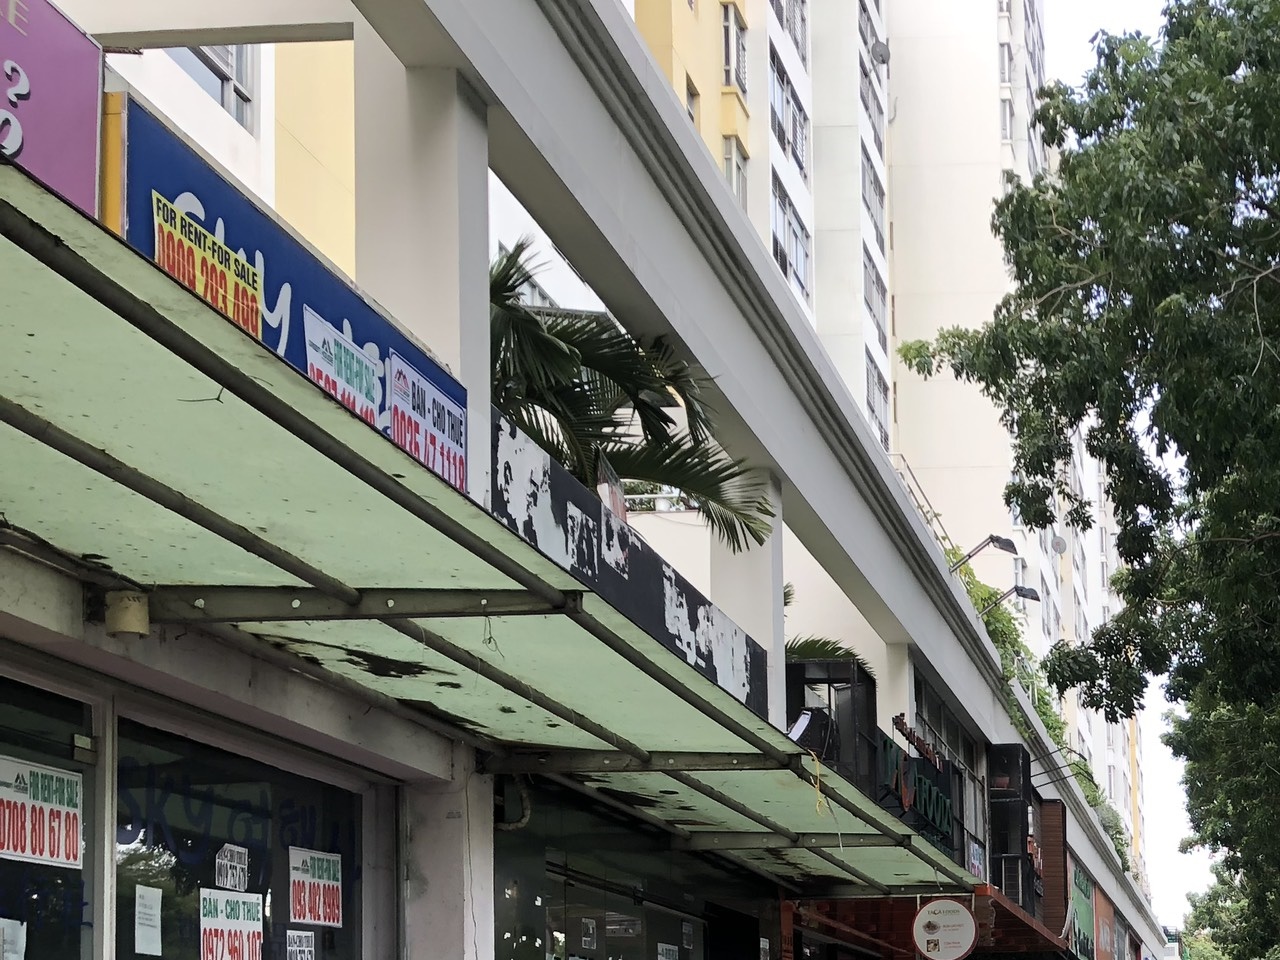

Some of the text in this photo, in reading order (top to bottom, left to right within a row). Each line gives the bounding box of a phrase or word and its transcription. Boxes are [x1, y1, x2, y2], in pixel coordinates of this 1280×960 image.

[156, 197, 258, 292] FOR RENT-FOR SALE
[411, 378, 426, 419] BÁN
[432, 397, 445, 434] CHO
[30, 804, 45, 857] 80
[48, 807, 62, 859] 67
[65, 810, 78, 862] 80
[202, 891, 219, 919] BÁN
[225, 899, 240, 921] CHO
[242, 896, 261, 923] THUÊ
